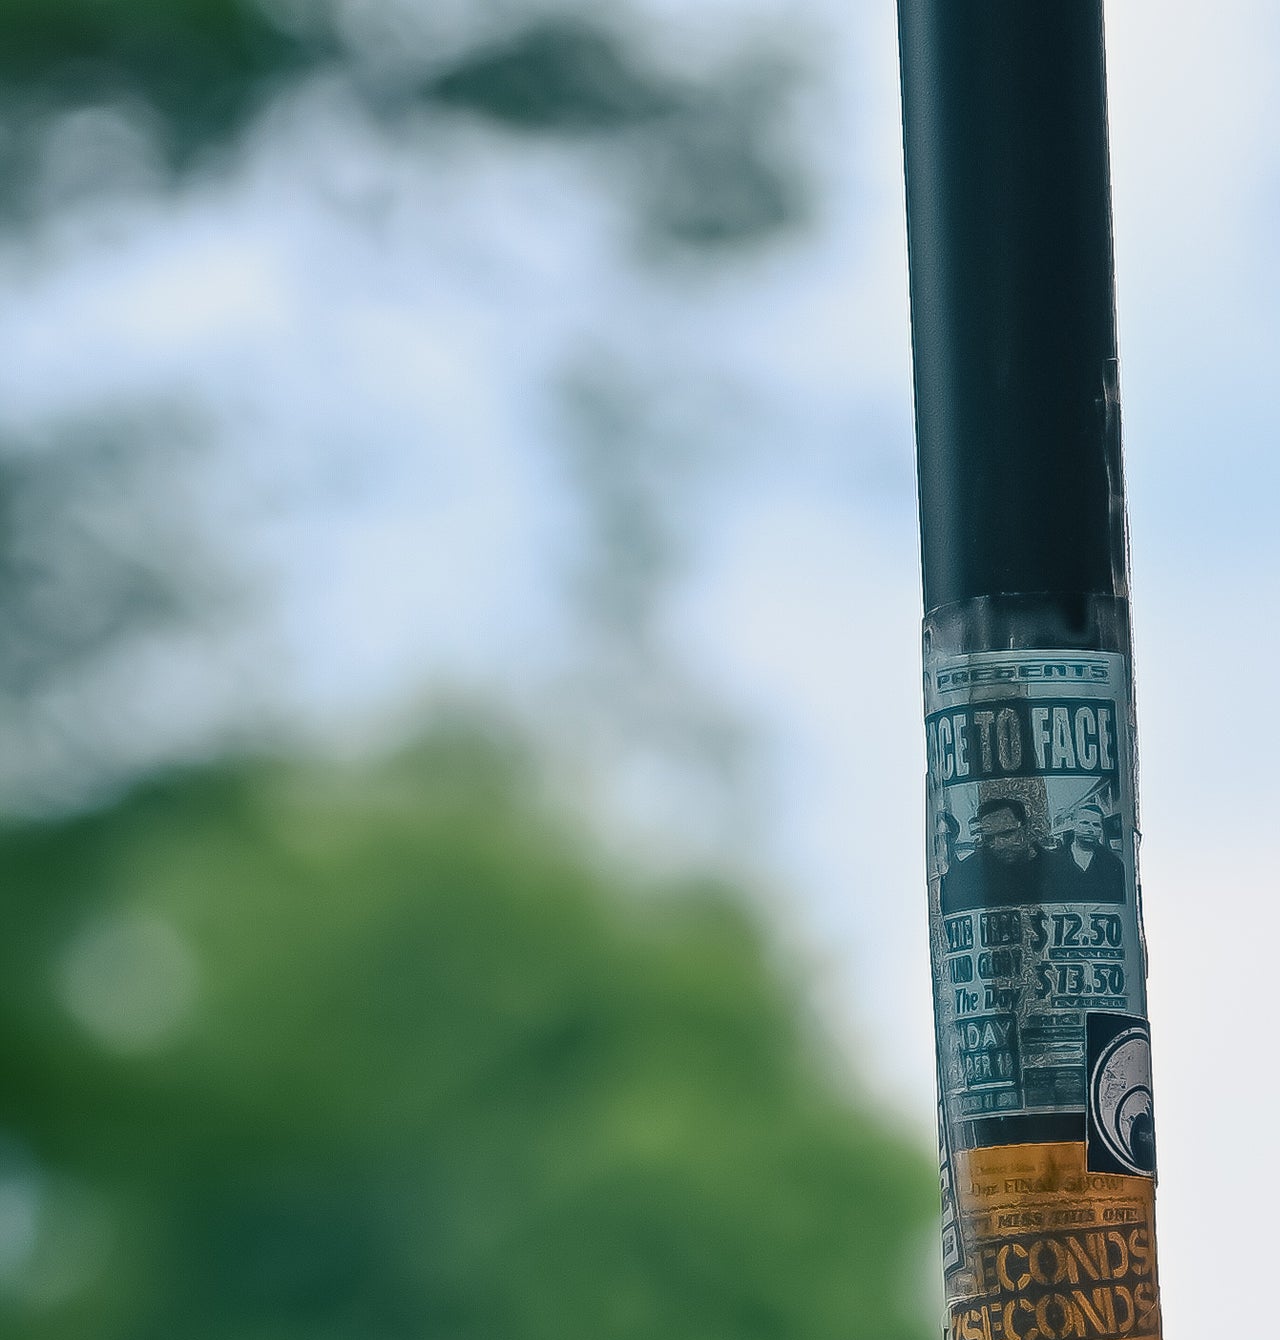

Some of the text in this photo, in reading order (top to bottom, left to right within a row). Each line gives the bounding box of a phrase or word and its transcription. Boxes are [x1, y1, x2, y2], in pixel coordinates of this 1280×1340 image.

[937, 664, 1109, 685] PRESENTS
[974, 707, 1021, 774] TO
[1032, 706, 1115, 771] FACE
[1030, 911, 1123, 951] $12.50
[1035, 961, 1125, 999] $13.50
[955, 988, 978, 1014] The
[976, 1228, 1153, 1294] ECONDS
